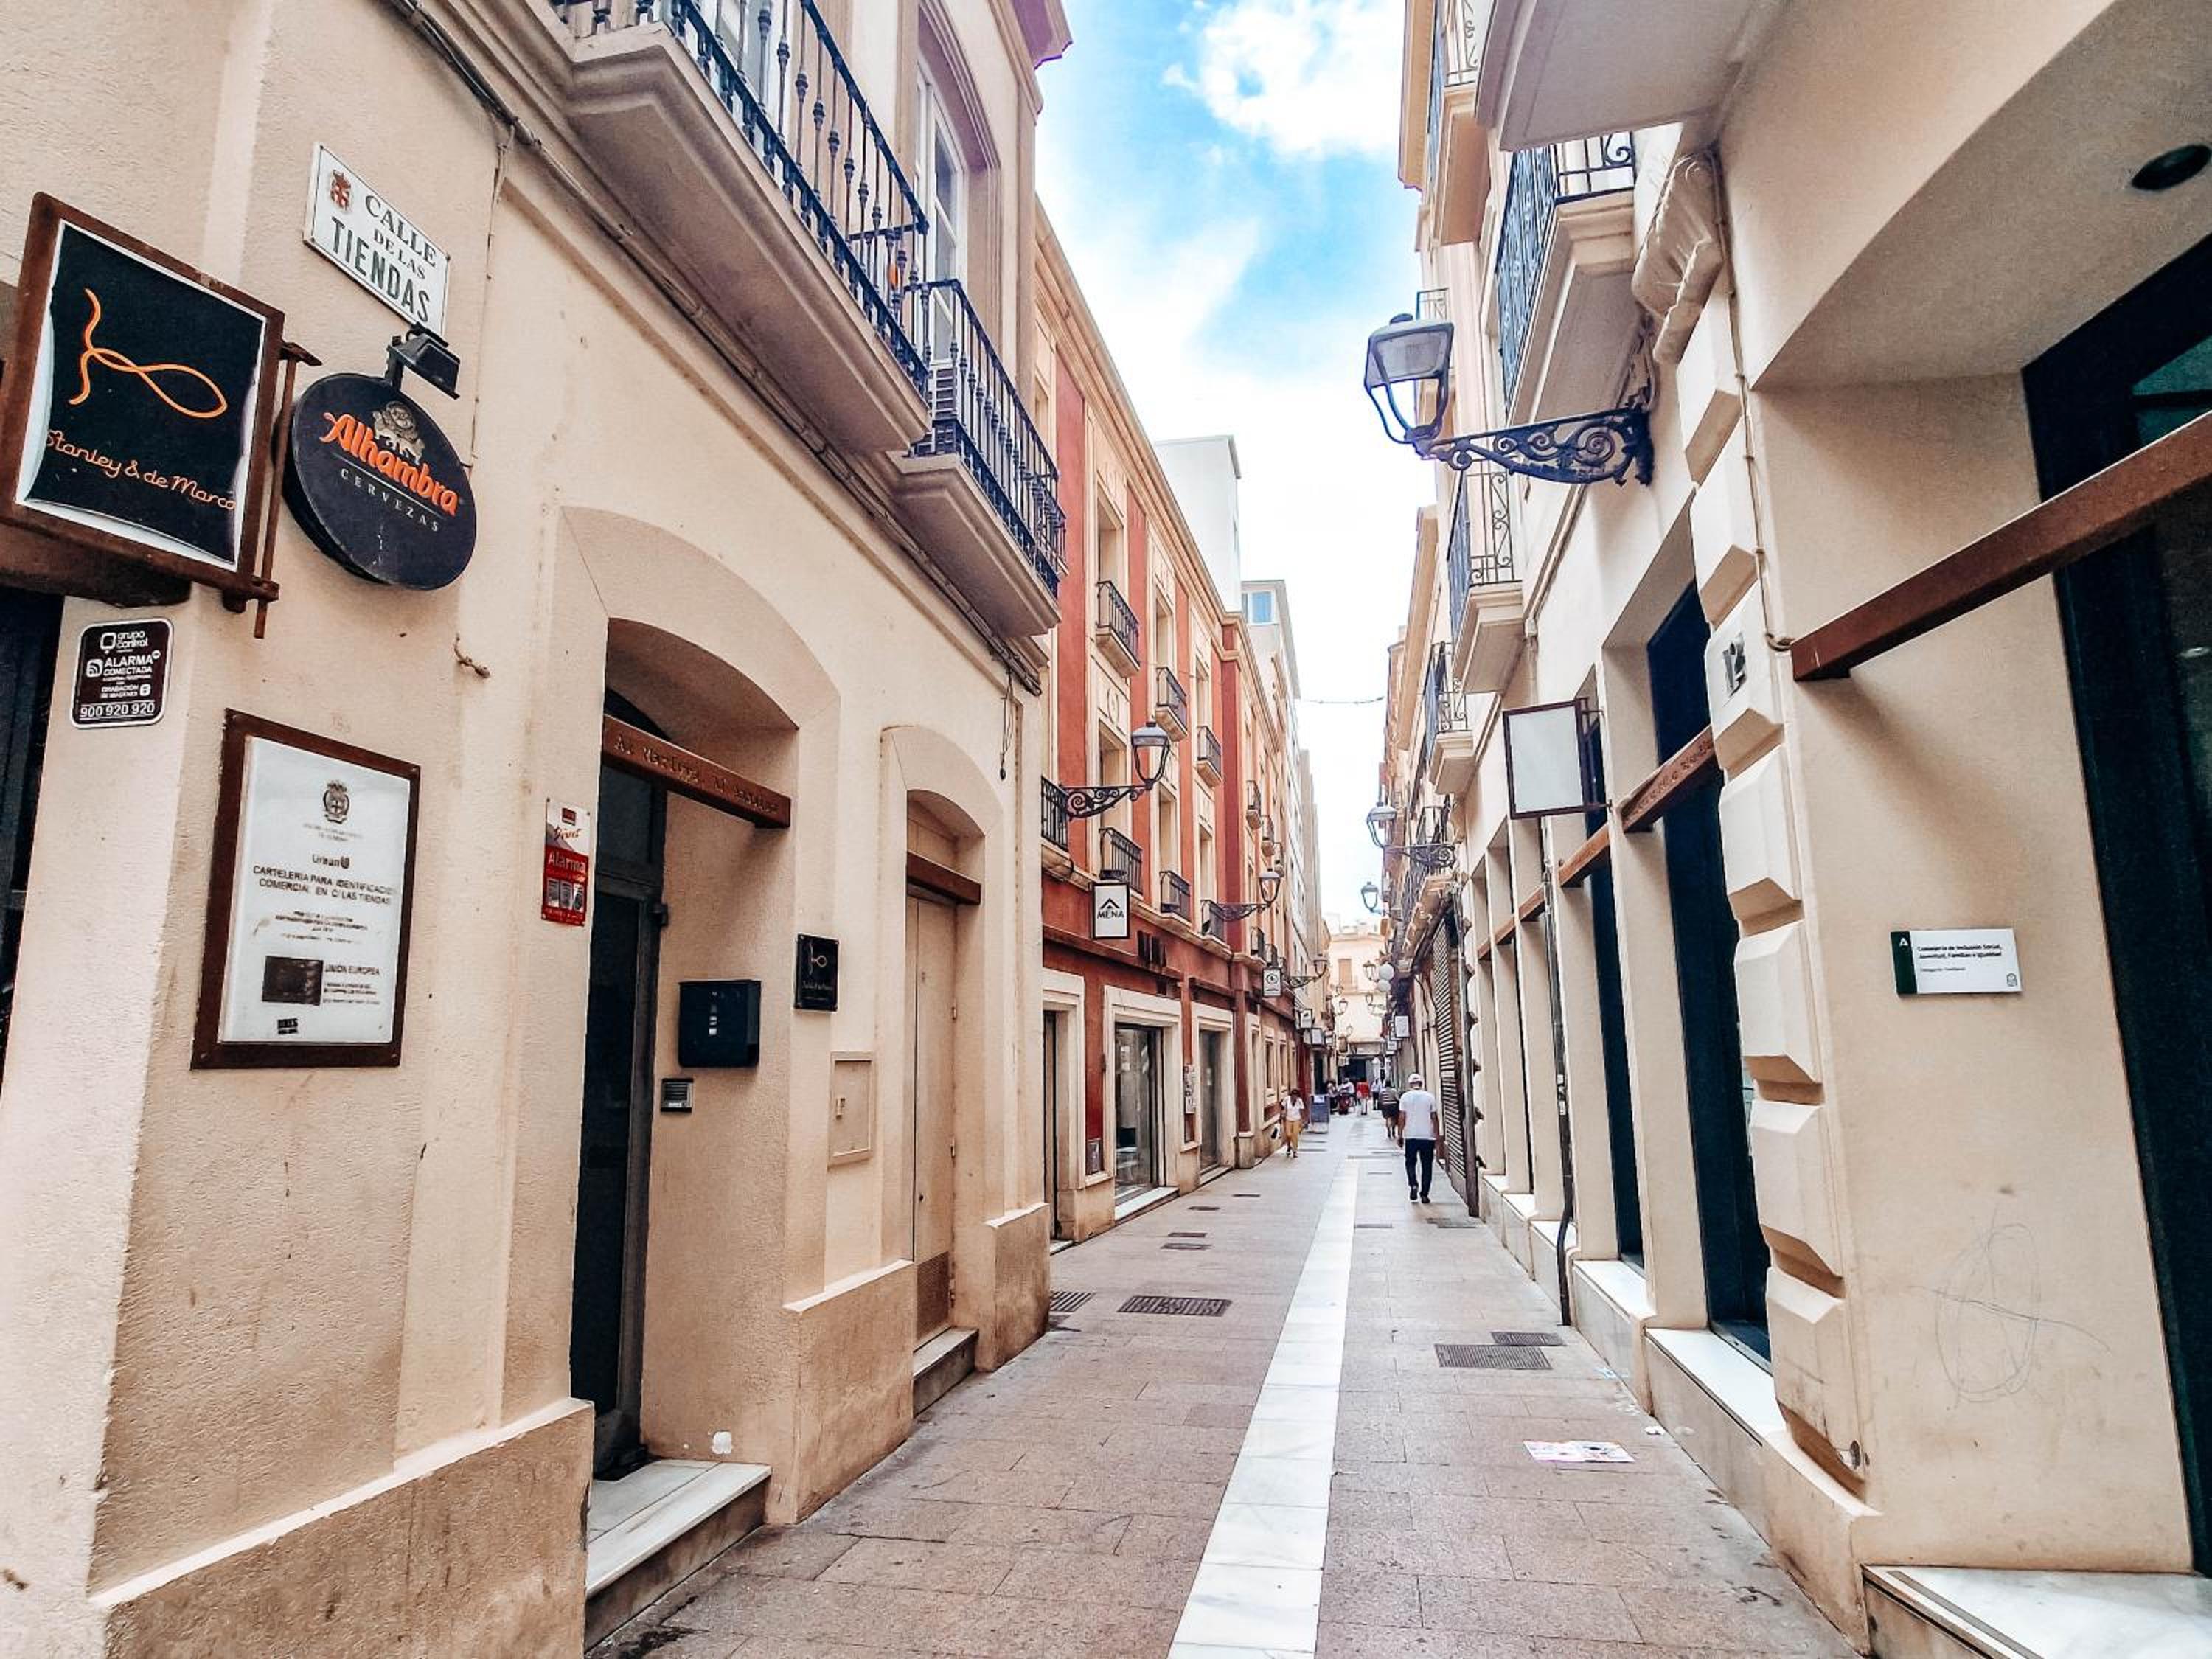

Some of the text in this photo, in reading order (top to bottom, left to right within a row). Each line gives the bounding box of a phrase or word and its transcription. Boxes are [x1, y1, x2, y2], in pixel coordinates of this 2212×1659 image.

[365, 195, 437, 268] CALLE
[374, 228, 425, 280] DE LAS
[331, 216, 430, 322] TIENDAS
[46, 429, 237, 509] Stanley & de Marco
[319, 412, 459, 517] Alhambra
[341, 467, 439, 532] CERVEZAS
[105, 655, 153, 667] ALARMA
[80, 703, 155, 717] 900 920 920
[310, 874, 333, 886] PARA
[316, 886, 328, 896] EN
[341, 891, 358, 900] LAS
[1096, 910, 1124, 919] MENA
